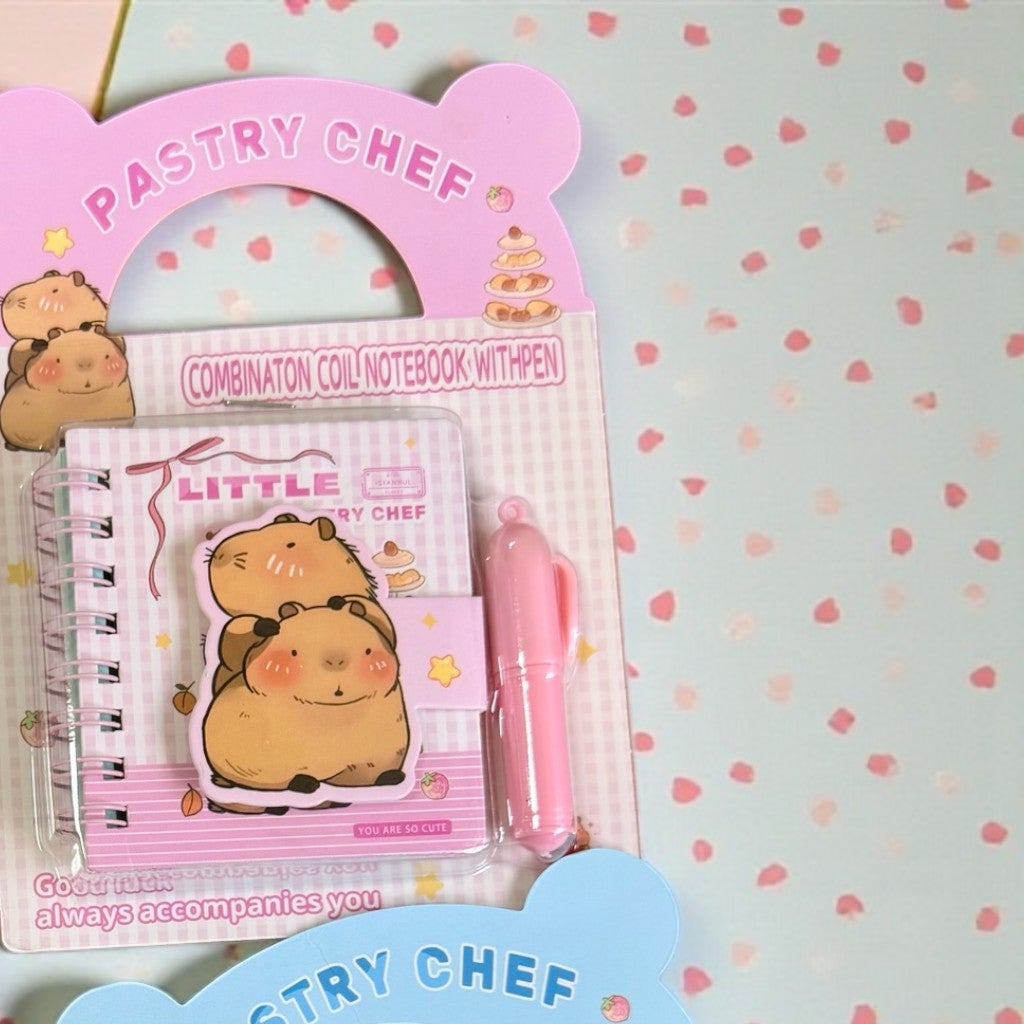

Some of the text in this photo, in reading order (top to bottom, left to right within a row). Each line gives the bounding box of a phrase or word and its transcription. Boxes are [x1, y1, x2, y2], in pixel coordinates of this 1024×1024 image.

[84, 115, 476, 232] PASTRY CHEF
[188, 343, 558, 399] COMBINATON COIL NOTEBOOK WITHPEN
[178, 472, 340, 500] LITTLE
[371, 505, 426, 520] CHEF
[358, 822, 447, 836] YOU ARE SO CUTE
[35, 889, 381, 932] always accompanies you
[415, 945, 578, 1007] CHEF
